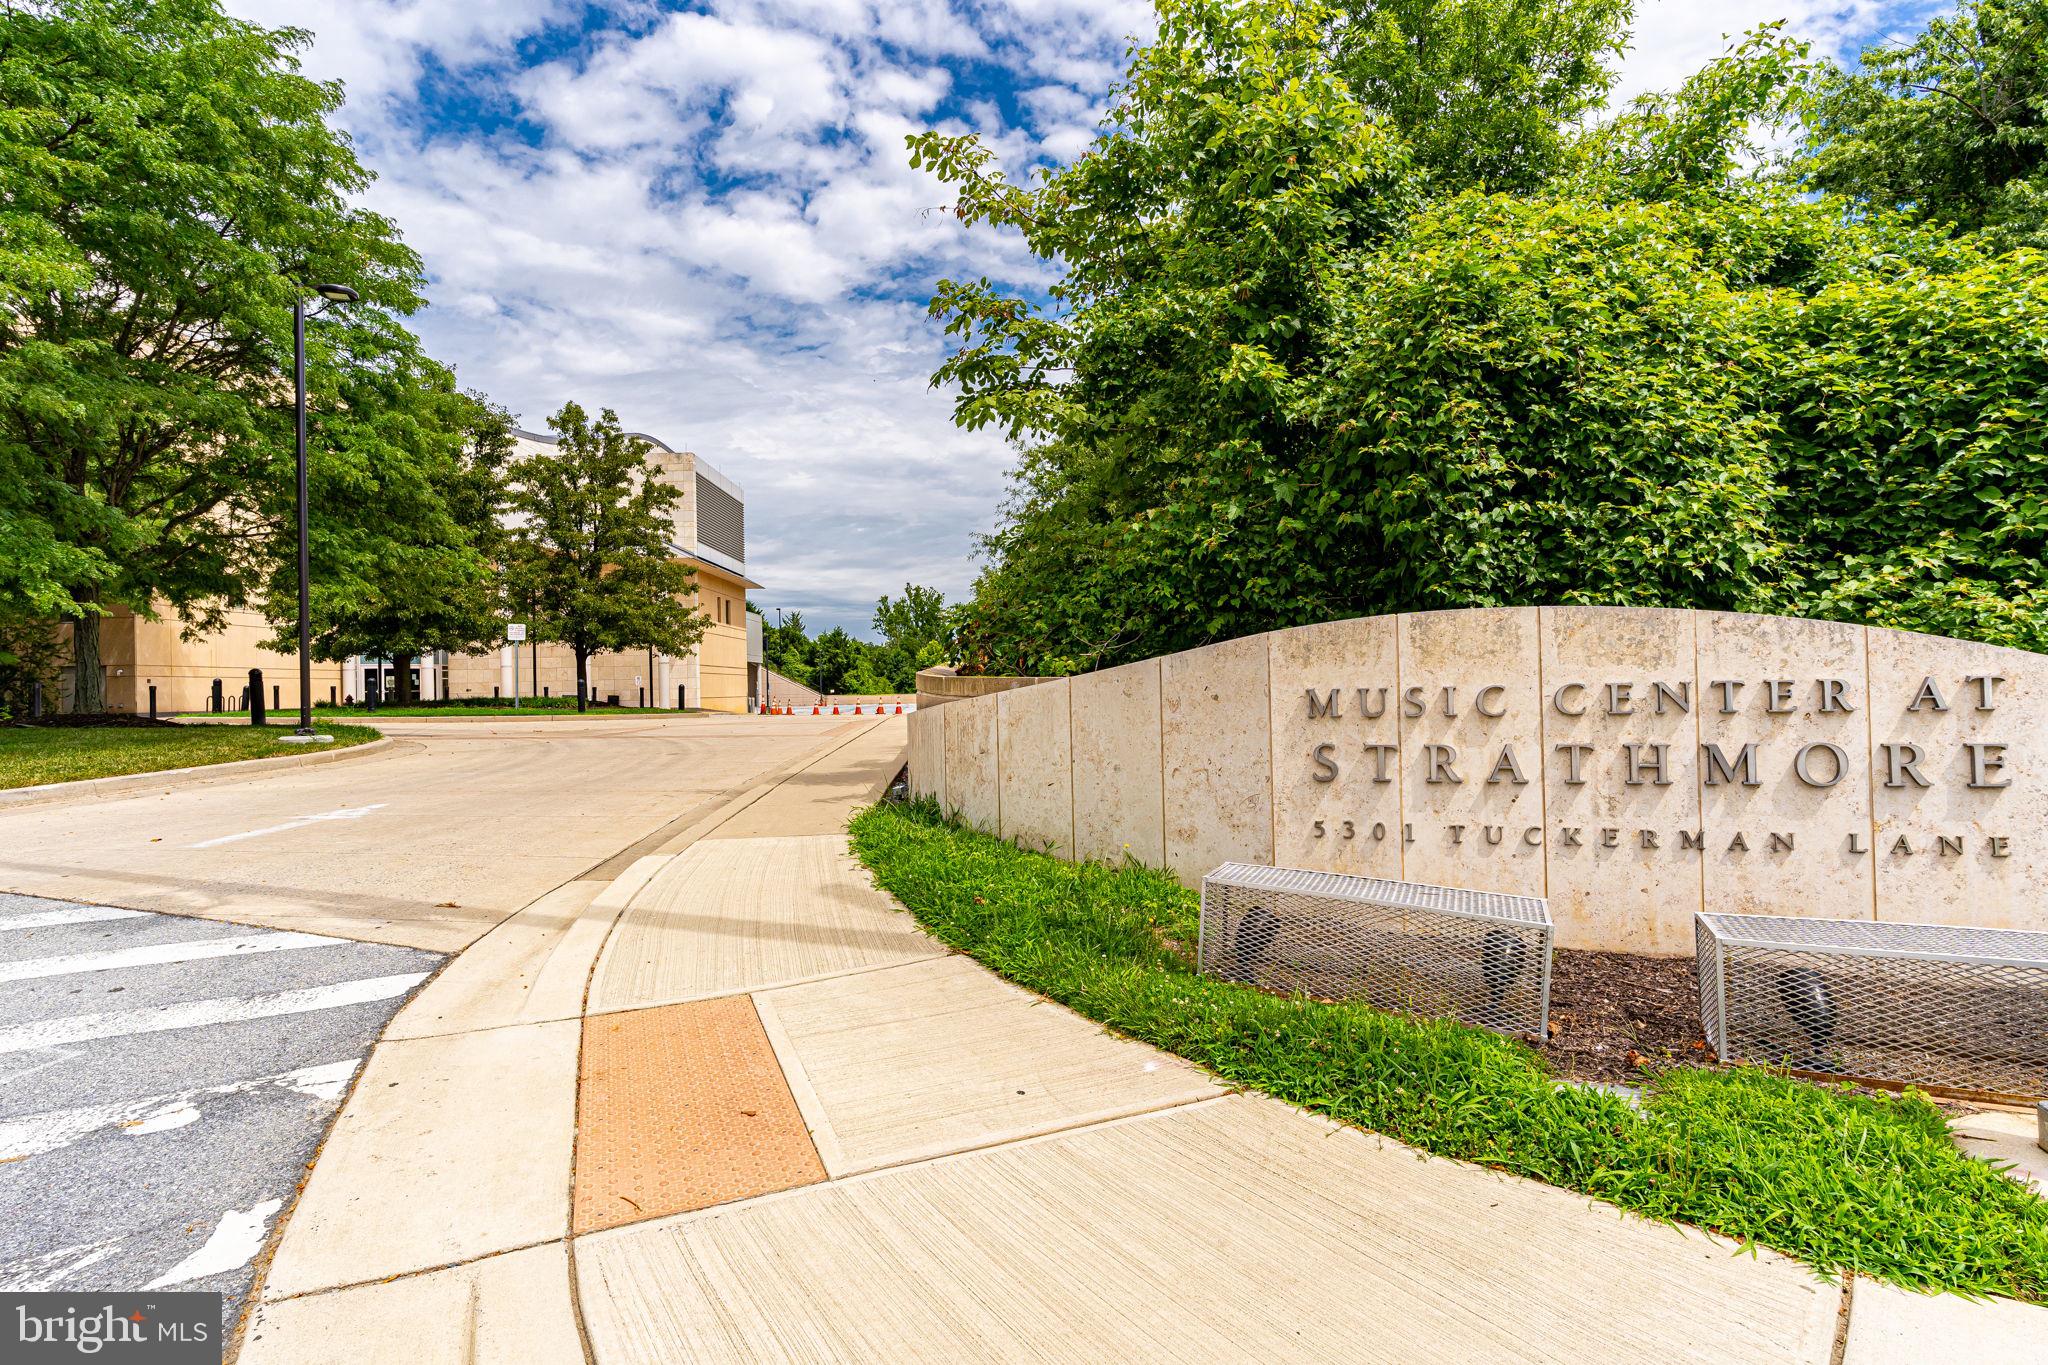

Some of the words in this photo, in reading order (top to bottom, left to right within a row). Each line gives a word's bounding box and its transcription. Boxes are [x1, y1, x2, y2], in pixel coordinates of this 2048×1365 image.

[1305, 684, 1507, 718] MUSIC
[1554, 679, 1855, 717] CENTER
[1907, 674, 2007, 712] AT
[1312, 742, 2014, 789] STRATHMORE
[1313, 819, 1416, 844] 5301
[1449, 824, 1795, 853] TUCKERMAN
[1849, 831, 2012, 858] LANE
